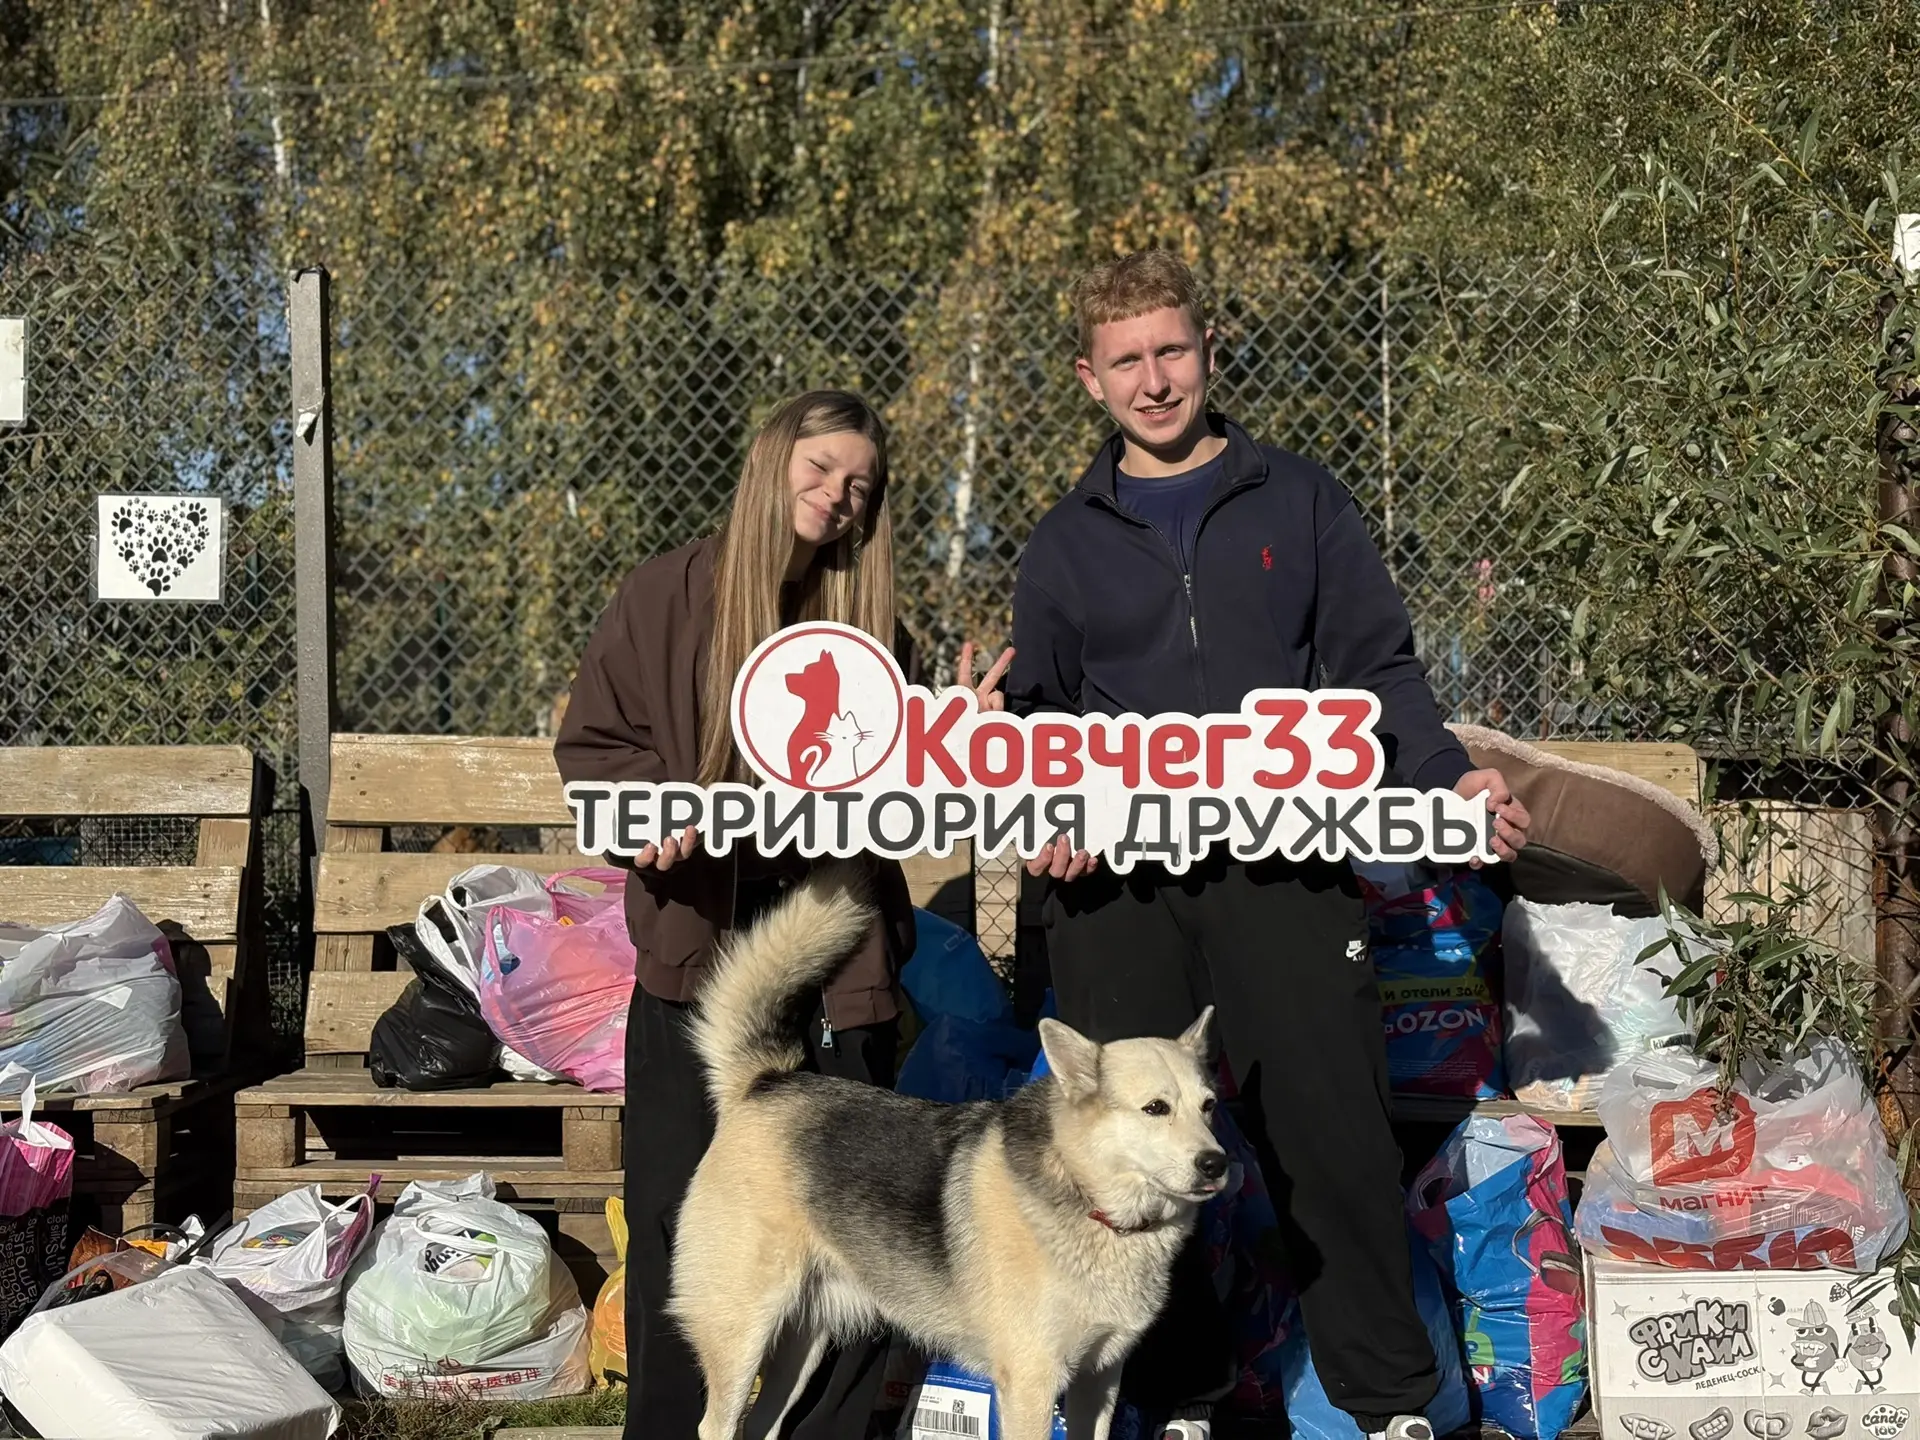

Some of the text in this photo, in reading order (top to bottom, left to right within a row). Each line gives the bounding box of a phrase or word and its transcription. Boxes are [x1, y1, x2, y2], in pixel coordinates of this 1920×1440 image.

[906, 698, 1377, 789] Ковчег33
[568, 789, 1497, 868] ТЕРРИТОРИЯ ДРУЖБЫ
[1401, 988, 1451, 999] отели
[1396, 1008, 1485, 1034] OZON
